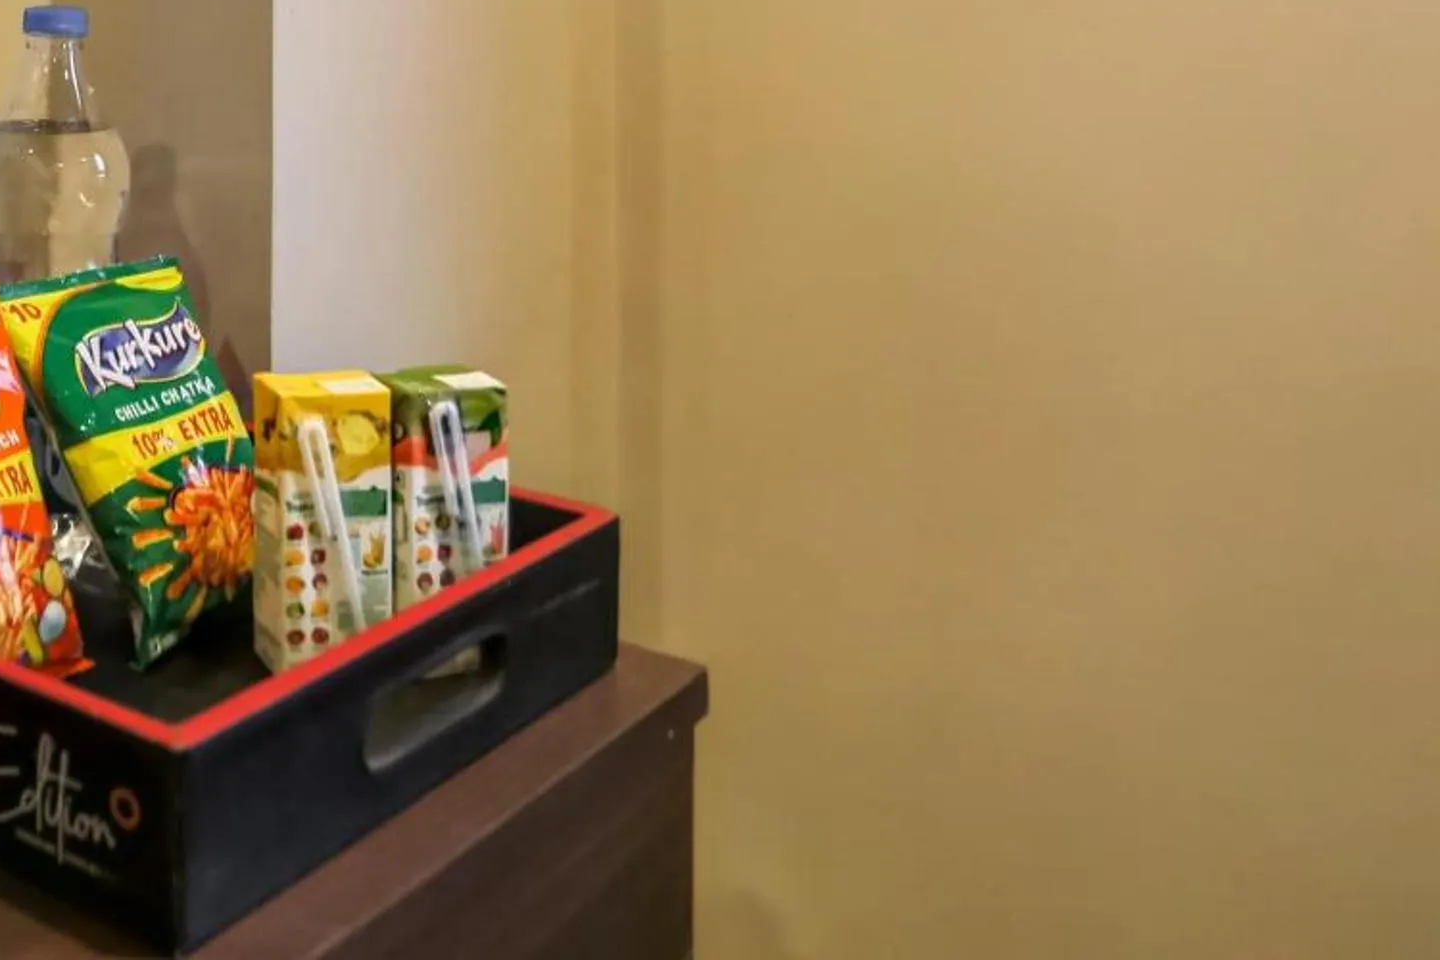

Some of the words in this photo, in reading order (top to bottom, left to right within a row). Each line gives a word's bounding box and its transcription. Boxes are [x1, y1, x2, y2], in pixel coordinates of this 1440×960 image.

[75, 318, 202, 391] Kurkure
[115, 395, 160, 422] CHILLI
[161, 376, 216, 406] CHATKA
[132, 429, 176, 460] 10%
[178, 402, 235, 440] EXTRA
